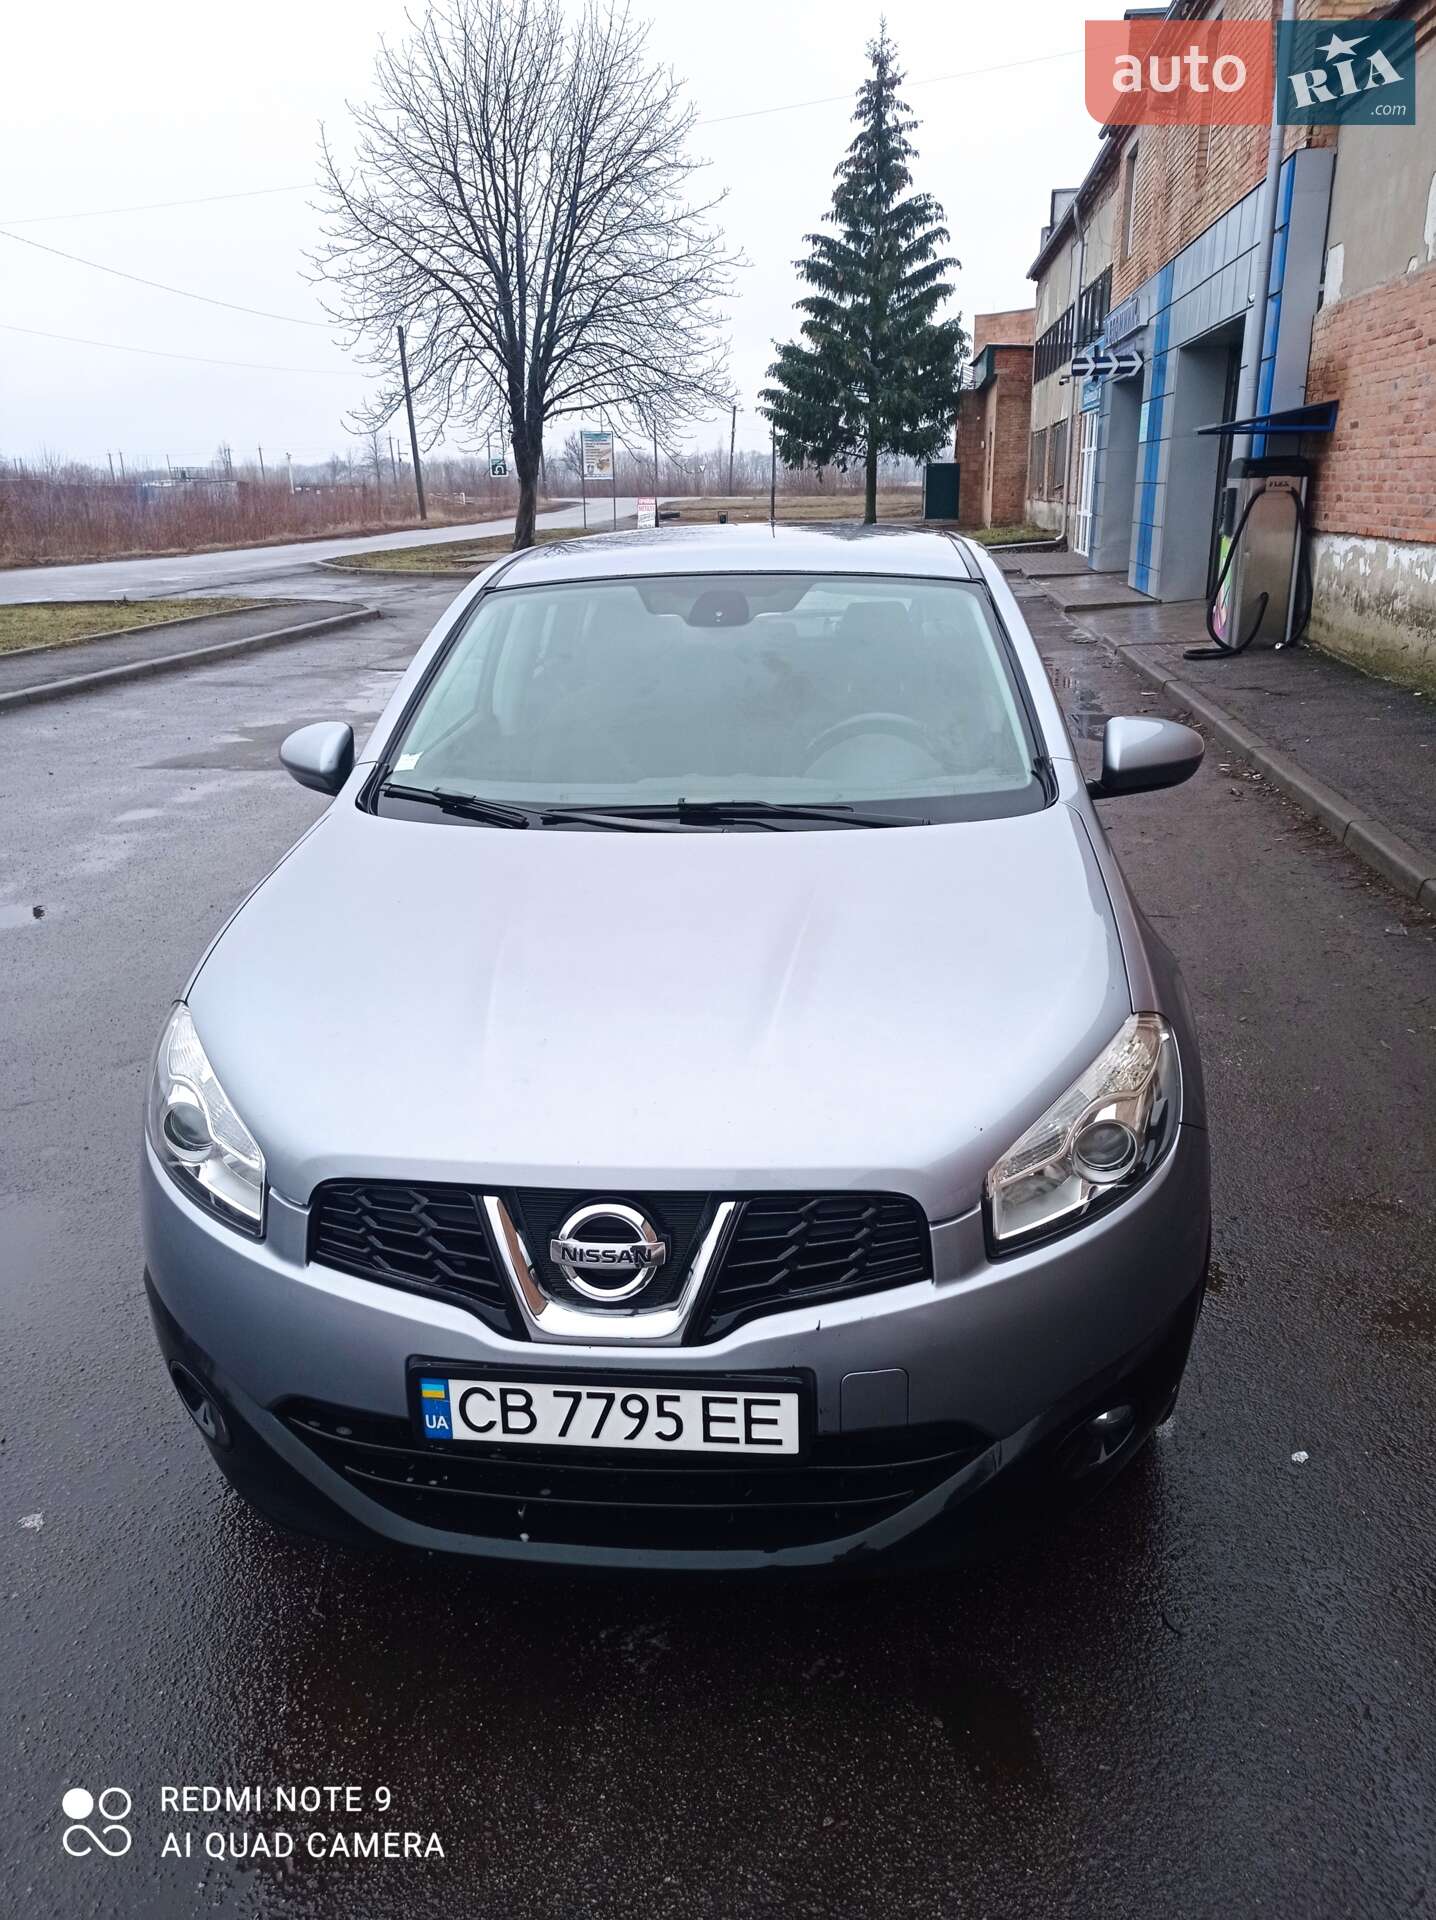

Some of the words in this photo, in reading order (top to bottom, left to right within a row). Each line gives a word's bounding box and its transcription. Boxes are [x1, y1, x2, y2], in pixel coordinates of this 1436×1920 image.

[561, 1246, 652, 1264] NISSAN
[425, 1414, 449, 1430] UA
[459, 1386, 538, 1434] CB
[553, 1390, 684, 1442] 7795
[702, 1395, 783, 1446] EE
